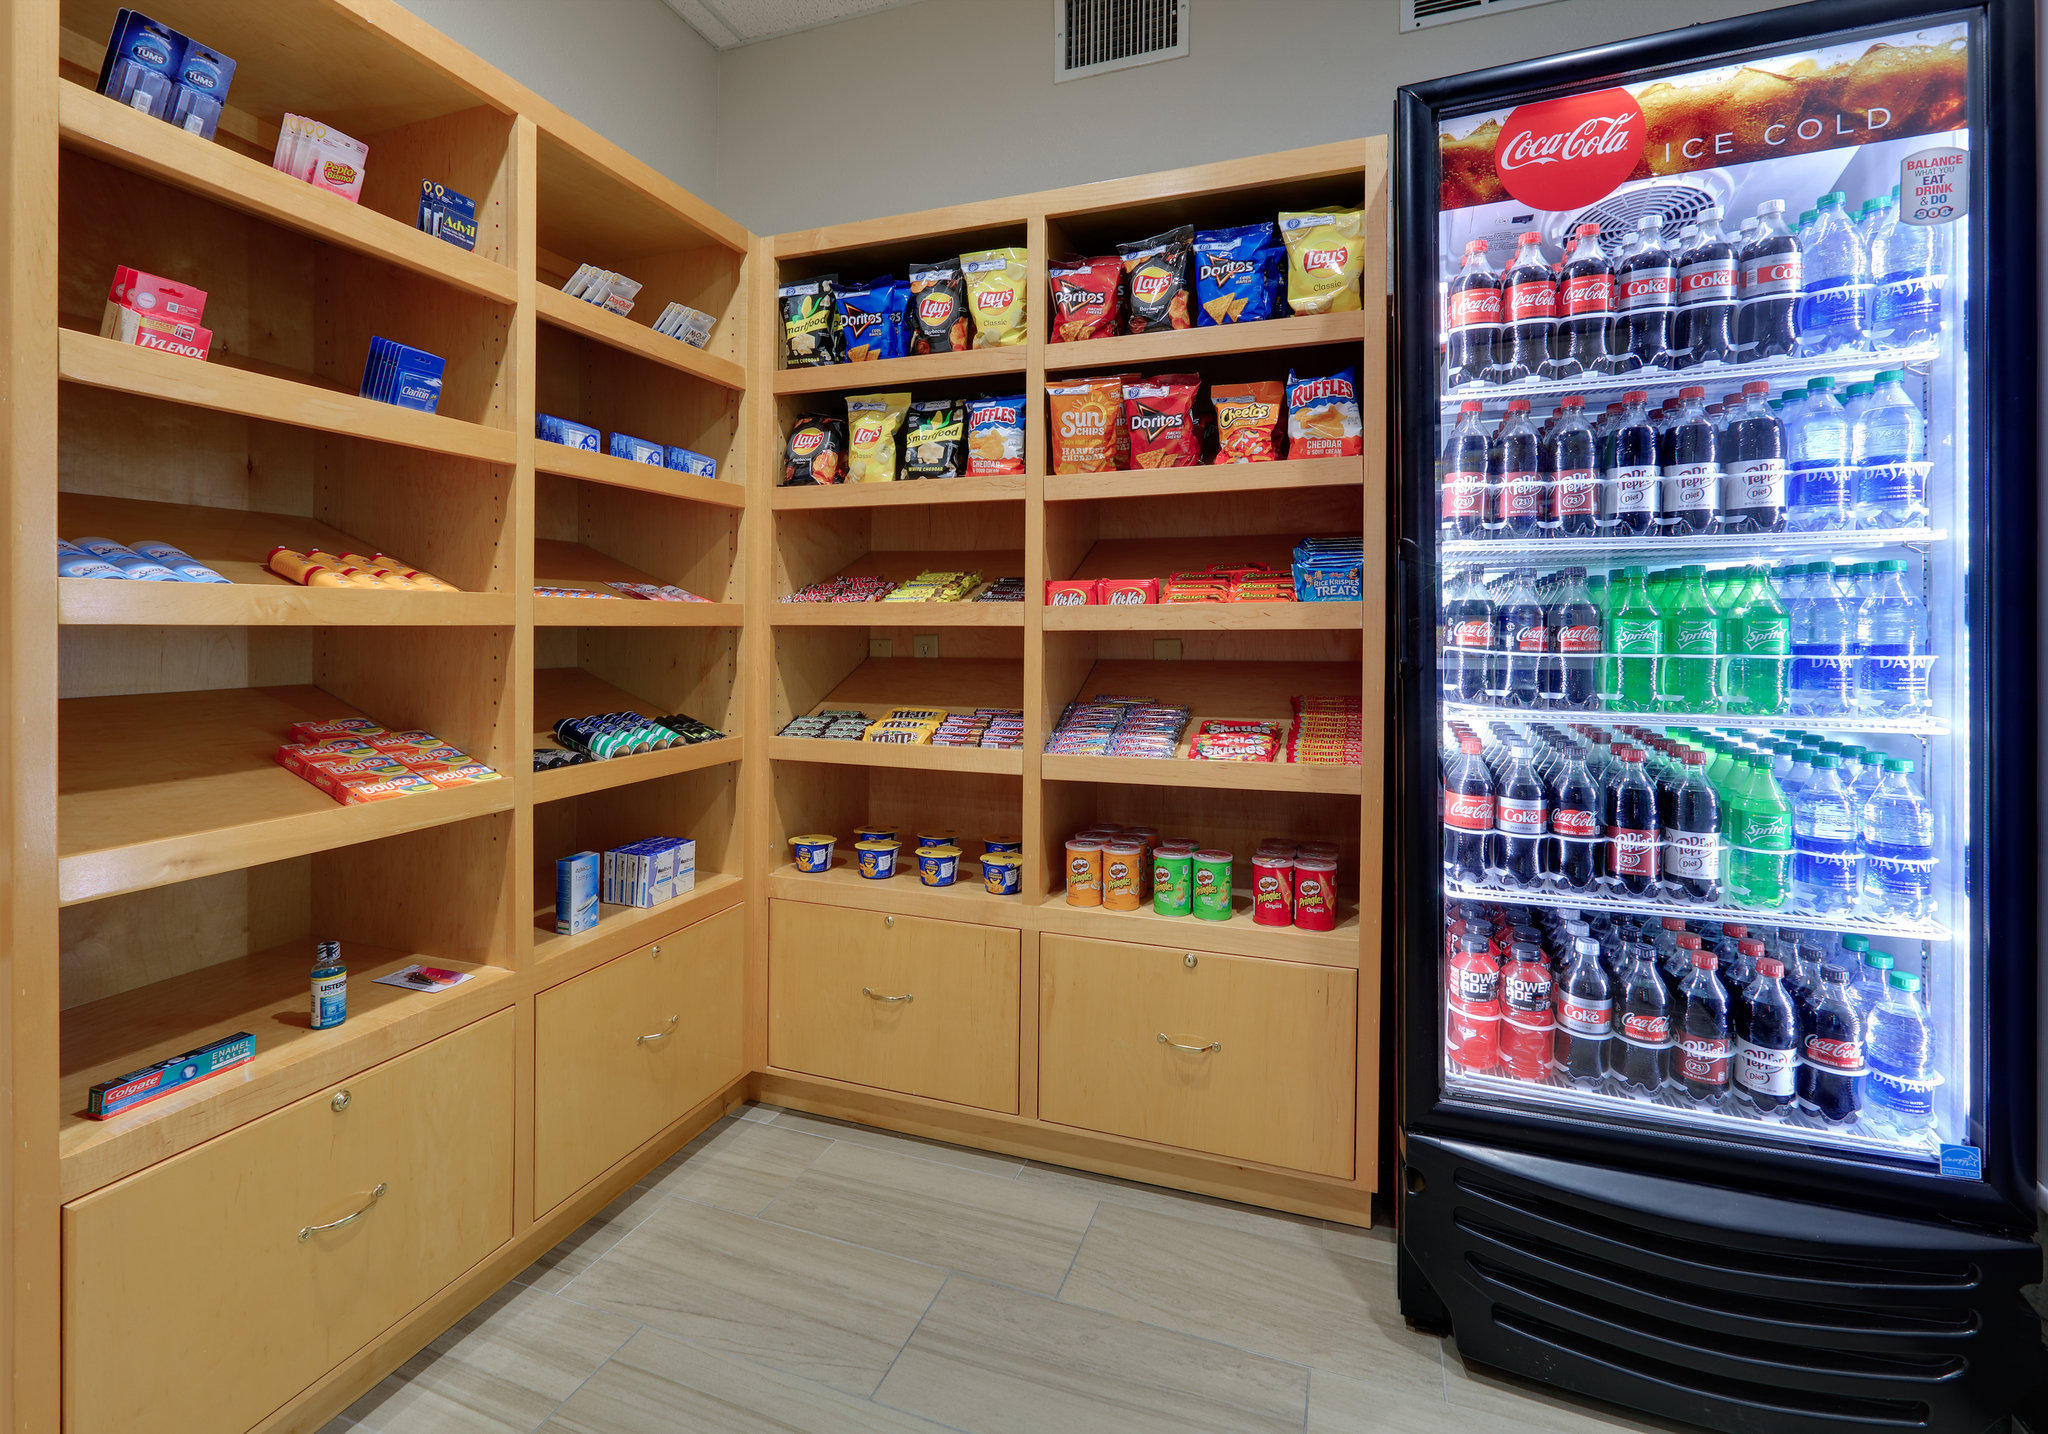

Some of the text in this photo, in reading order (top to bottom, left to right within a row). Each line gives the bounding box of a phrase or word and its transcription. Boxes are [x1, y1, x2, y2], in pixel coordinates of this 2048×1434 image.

[136, 46, 165, 65] TUMS
[187, 71, 214, 89] TUMS
[1500, 111, 1638, 171] Coca-Cola
[1665, 108, 1892, 163] ICE COLD
[324, 160, 357, 177] Pepto-
[1907, 155, 1963, 170] BALANCE
[326, 171, 354, 184] Bismol
[1915, 166, 1955, 176] WHAT YOU
[1923, 174, 1945, 185] EAT
[1915, 183, 1953, 196] DRINK
[1920, 194, 1947, 206] & DO
[443, 215, 476, 238] Advil
[1307, 249, 1346, 270] Lay's
[1200, 261, 1254, 280] Doritos
[1136, 276, 1170, 294] Lay's
[1313, 281, 1342, 292] Classic
[1627, 280, 1666, 296] Coke
[1690, 272, 1729, 289] Coke
[977, 289, 1014, 308] Lay's
[1055, 292, 1104, 304] Doritos
[1511, 289, 1555, 310] Coca-Cola
[1562, 282, 1611, 305] Coca-Cola
[922, 298, 952, 318] Lay's
[1458, 295, 1500, 315] Coca-Cola
[787, 314, 827, 335] martfood
[840, 312, 882, 326] Doritos
[983, 318, 1008, 327] Classic
[139, 332, 206, 360] TYLENOL
[402, 385, 430, 401] Claritin
[1291, 380, 1353, 407] RUFFLES
[1131, 414, 1183, 431] Doritos
[1220, 403, 1269, 427] Cheetos
[1060, 411, 1106, 438] Sun
[1075, 427, 1105, 436] CHIPS
[794, 433, 824, 449] Lay's
[907, 427, 958, 446] Smartfood
[1307, 440, 1342, 449] CHEDDAR
[972, 460, 1000, 469] CHEDDAR
[1625, 494, 1639, 503] Diet
[1685, 492, 1700, 501] Diet
[1753, 488, 1767, 498] Diet
[1315, 586, 1358, 596] TREATS
[1557, 625, 1601, 642] Coca-Cola
[1622, 630, 1654, 642] Sprite
[1678, 630, 1712, 642] Sprite
[1750, 630, 1785, 642] Sprite
[310, 720, 359, 733] bounce
[300, 740, 351, 755] bounce
[373, 732, 420, 747] bounce
[401, 748, 449, 764] bounce
[1201, 745, 1266, 757] Skittles
[329, 758, 382, 775] bounce
[431, 766, 477, 782] bounce
[359, 777, 411, 794] bounce
[1450, 801, 1494, 819] Coca-Cola
[1503, 809, 1539, 824] Coke
[1551, 807, 1599, 827] Coca-Cola
[1628, 833, 1643, 842] Dr
[1749, 824, 1785, 836] Sprite
[1690, 837, 1705, 846] Dr
[1071, 872, 1092, 884] Pringles
[1108, 877, 1131, 891] Pringles
[1195, 885, 1217, 897] Pringles
[1257, 891, 1281, 905] Pringles
[1299, 895, 1323, 908] Pringles
[1460, 981, 1488, 994] ADE
[1506, 976, 1551, 992] POWER
[1506, 986, 1533, 1002] ADE
[1564, 1004, 1600, 1023] Coke
[1622, 1012, 1670, 1032] Coca-Cola
[212, 1040, 250, 1059] ENAMEL
[1697, 1040, 1714, 1051] Dr
[1805, 1034, 1864, 1059] Coca-Cola
[212, 1048, 249, 1065] HEALTH
[1758, 1050, 1774, 1060] Dr
[107, 1075, 159, 1101] Colgate
